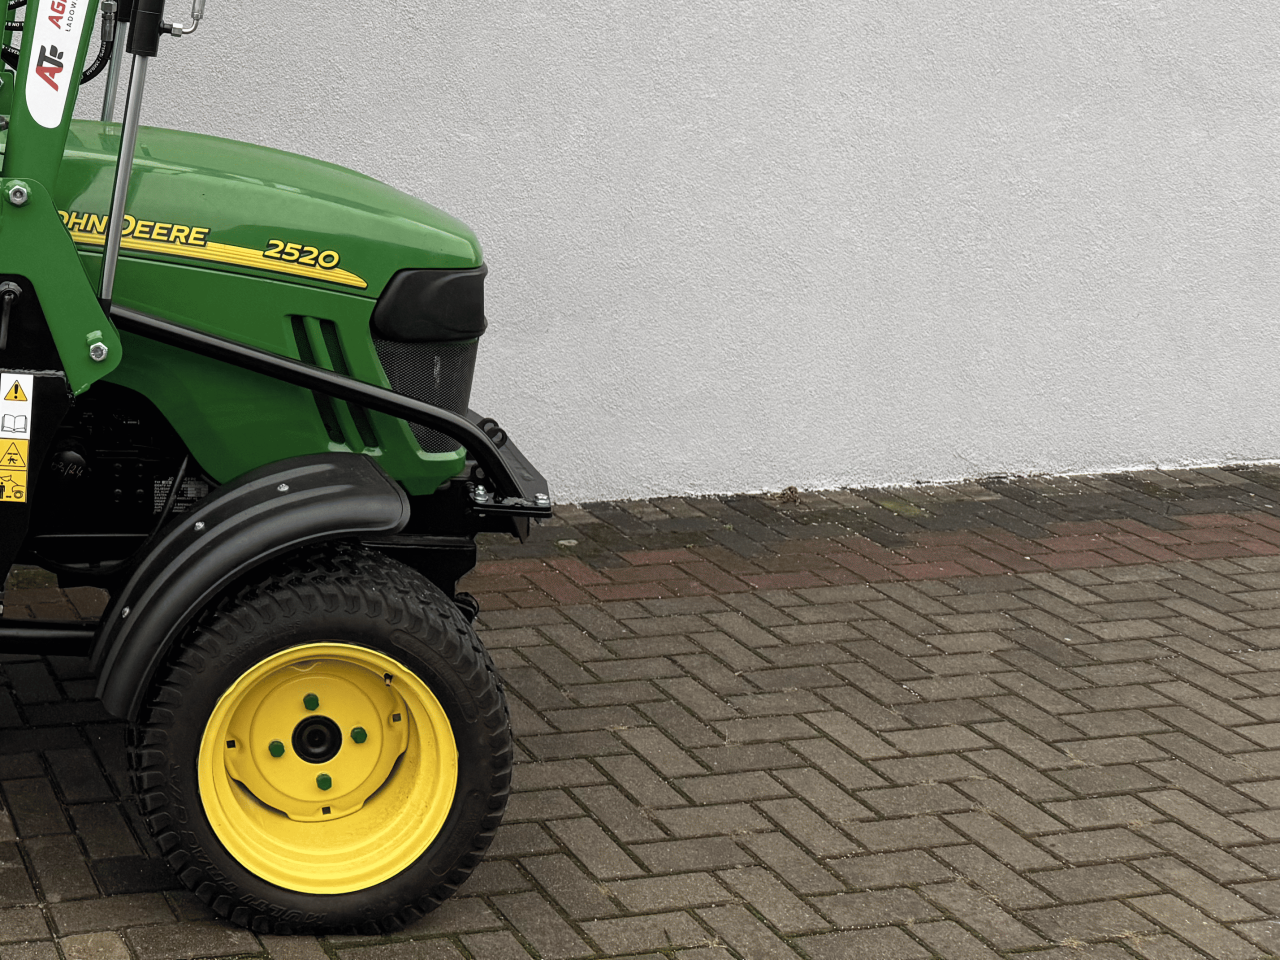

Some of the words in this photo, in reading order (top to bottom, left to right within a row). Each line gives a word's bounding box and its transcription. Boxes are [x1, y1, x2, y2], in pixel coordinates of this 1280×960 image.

[57, 210, 108, 232] OHN
[121, 214, 210, 246] DEERE
[262, 240, 340, 269] 2520
